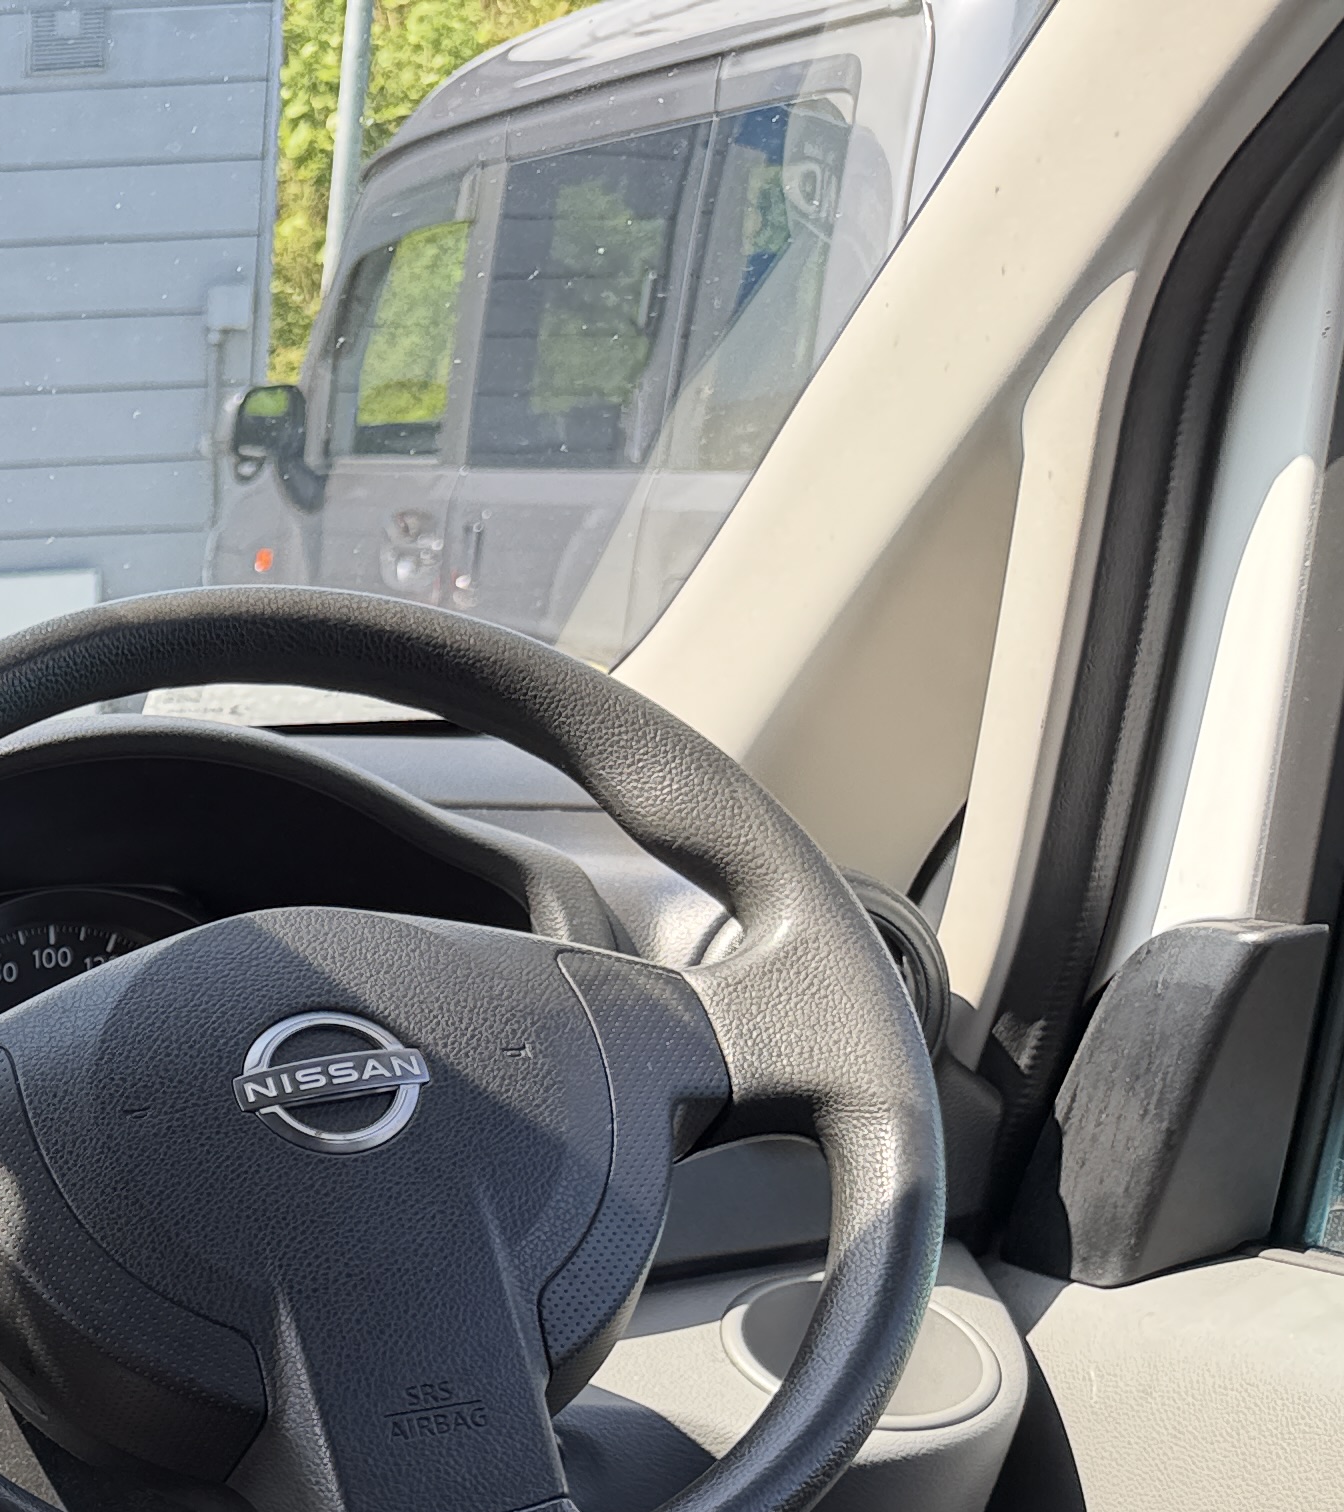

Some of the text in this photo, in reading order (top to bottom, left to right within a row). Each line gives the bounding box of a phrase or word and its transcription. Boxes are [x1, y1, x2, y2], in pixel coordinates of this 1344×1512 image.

[32, 946, 73, 969] 100
[242, 1054, 423, 1104] NISSAN
[405, 1380, 453, 1407] SRS
[388, 1406, 489, 1443] AIRBAG
